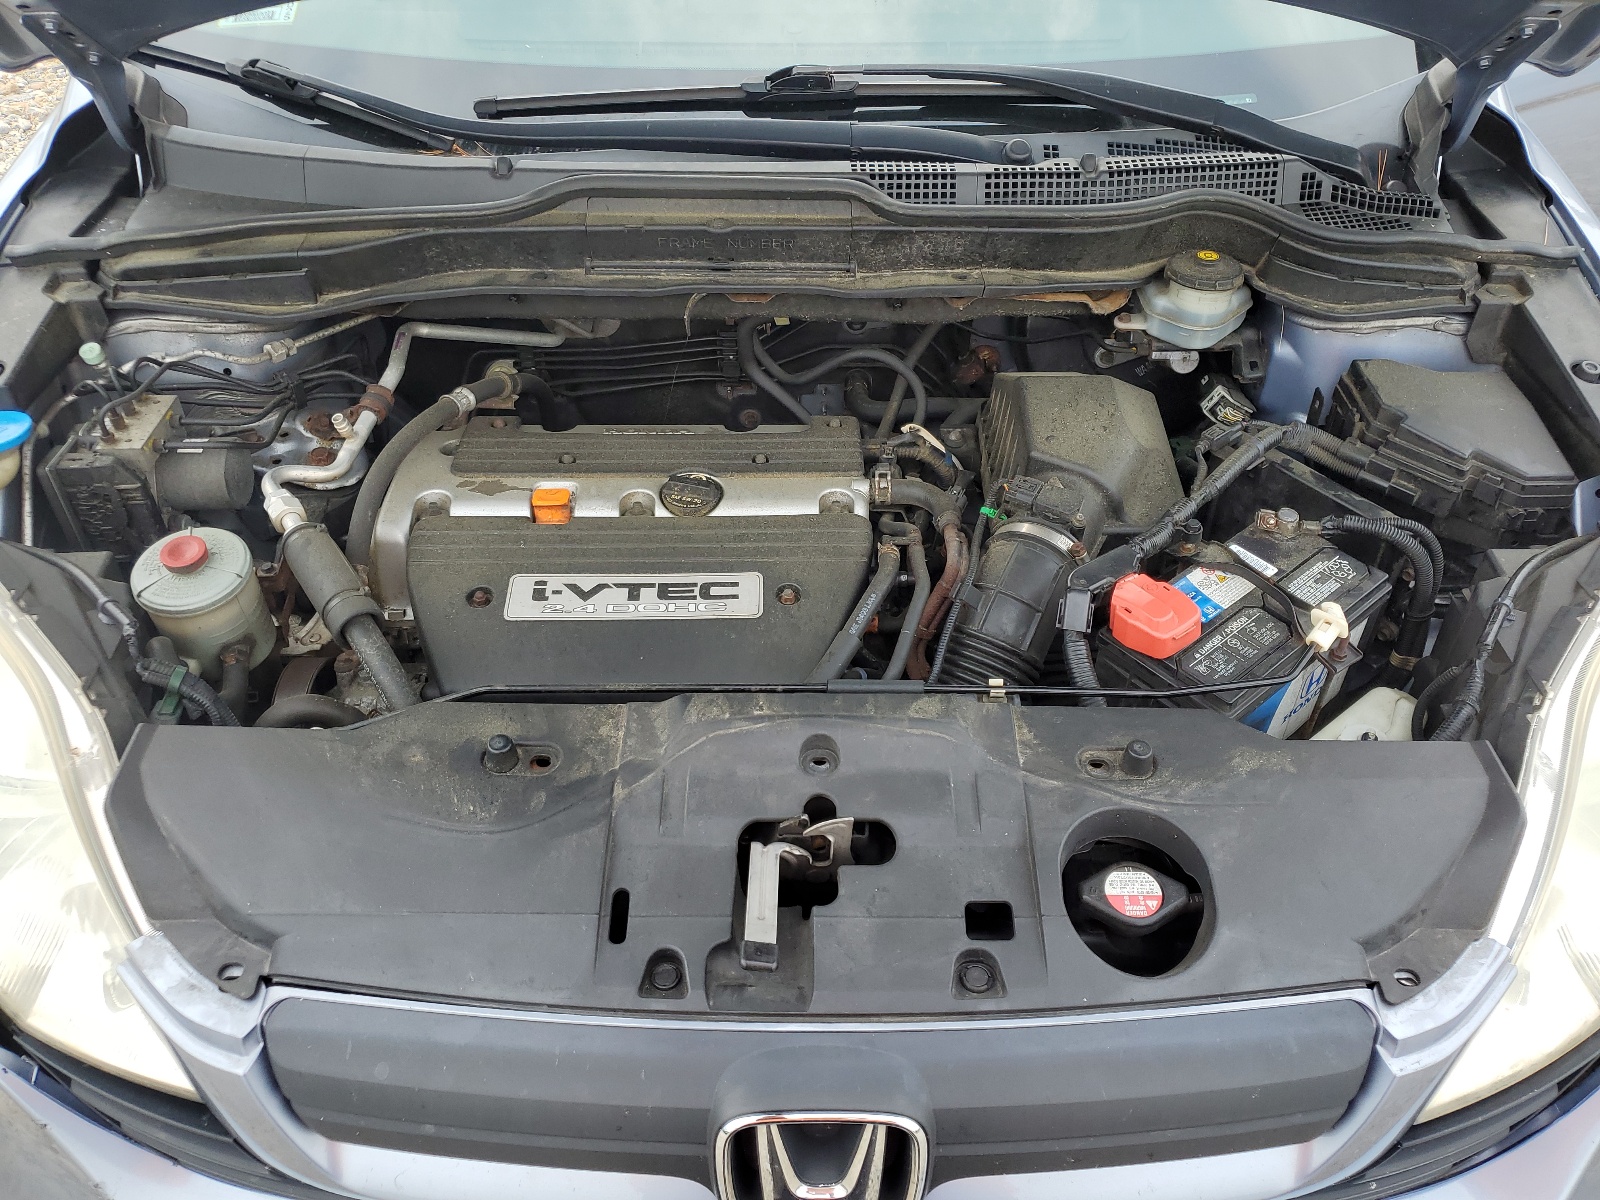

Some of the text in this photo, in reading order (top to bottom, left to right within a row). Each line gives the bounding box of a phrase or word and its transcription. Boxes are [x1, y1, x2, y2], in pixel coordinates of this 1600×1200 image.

[657, 237, 794, 249] FRAME NUMBER
[532, 579, 740, 602] i-VTEC
[541, 602, 727, 614] 2.4 DOHC
[1198, 633, 1223, 656] DANGER
[1225, 615, 1249, 637] POISON
